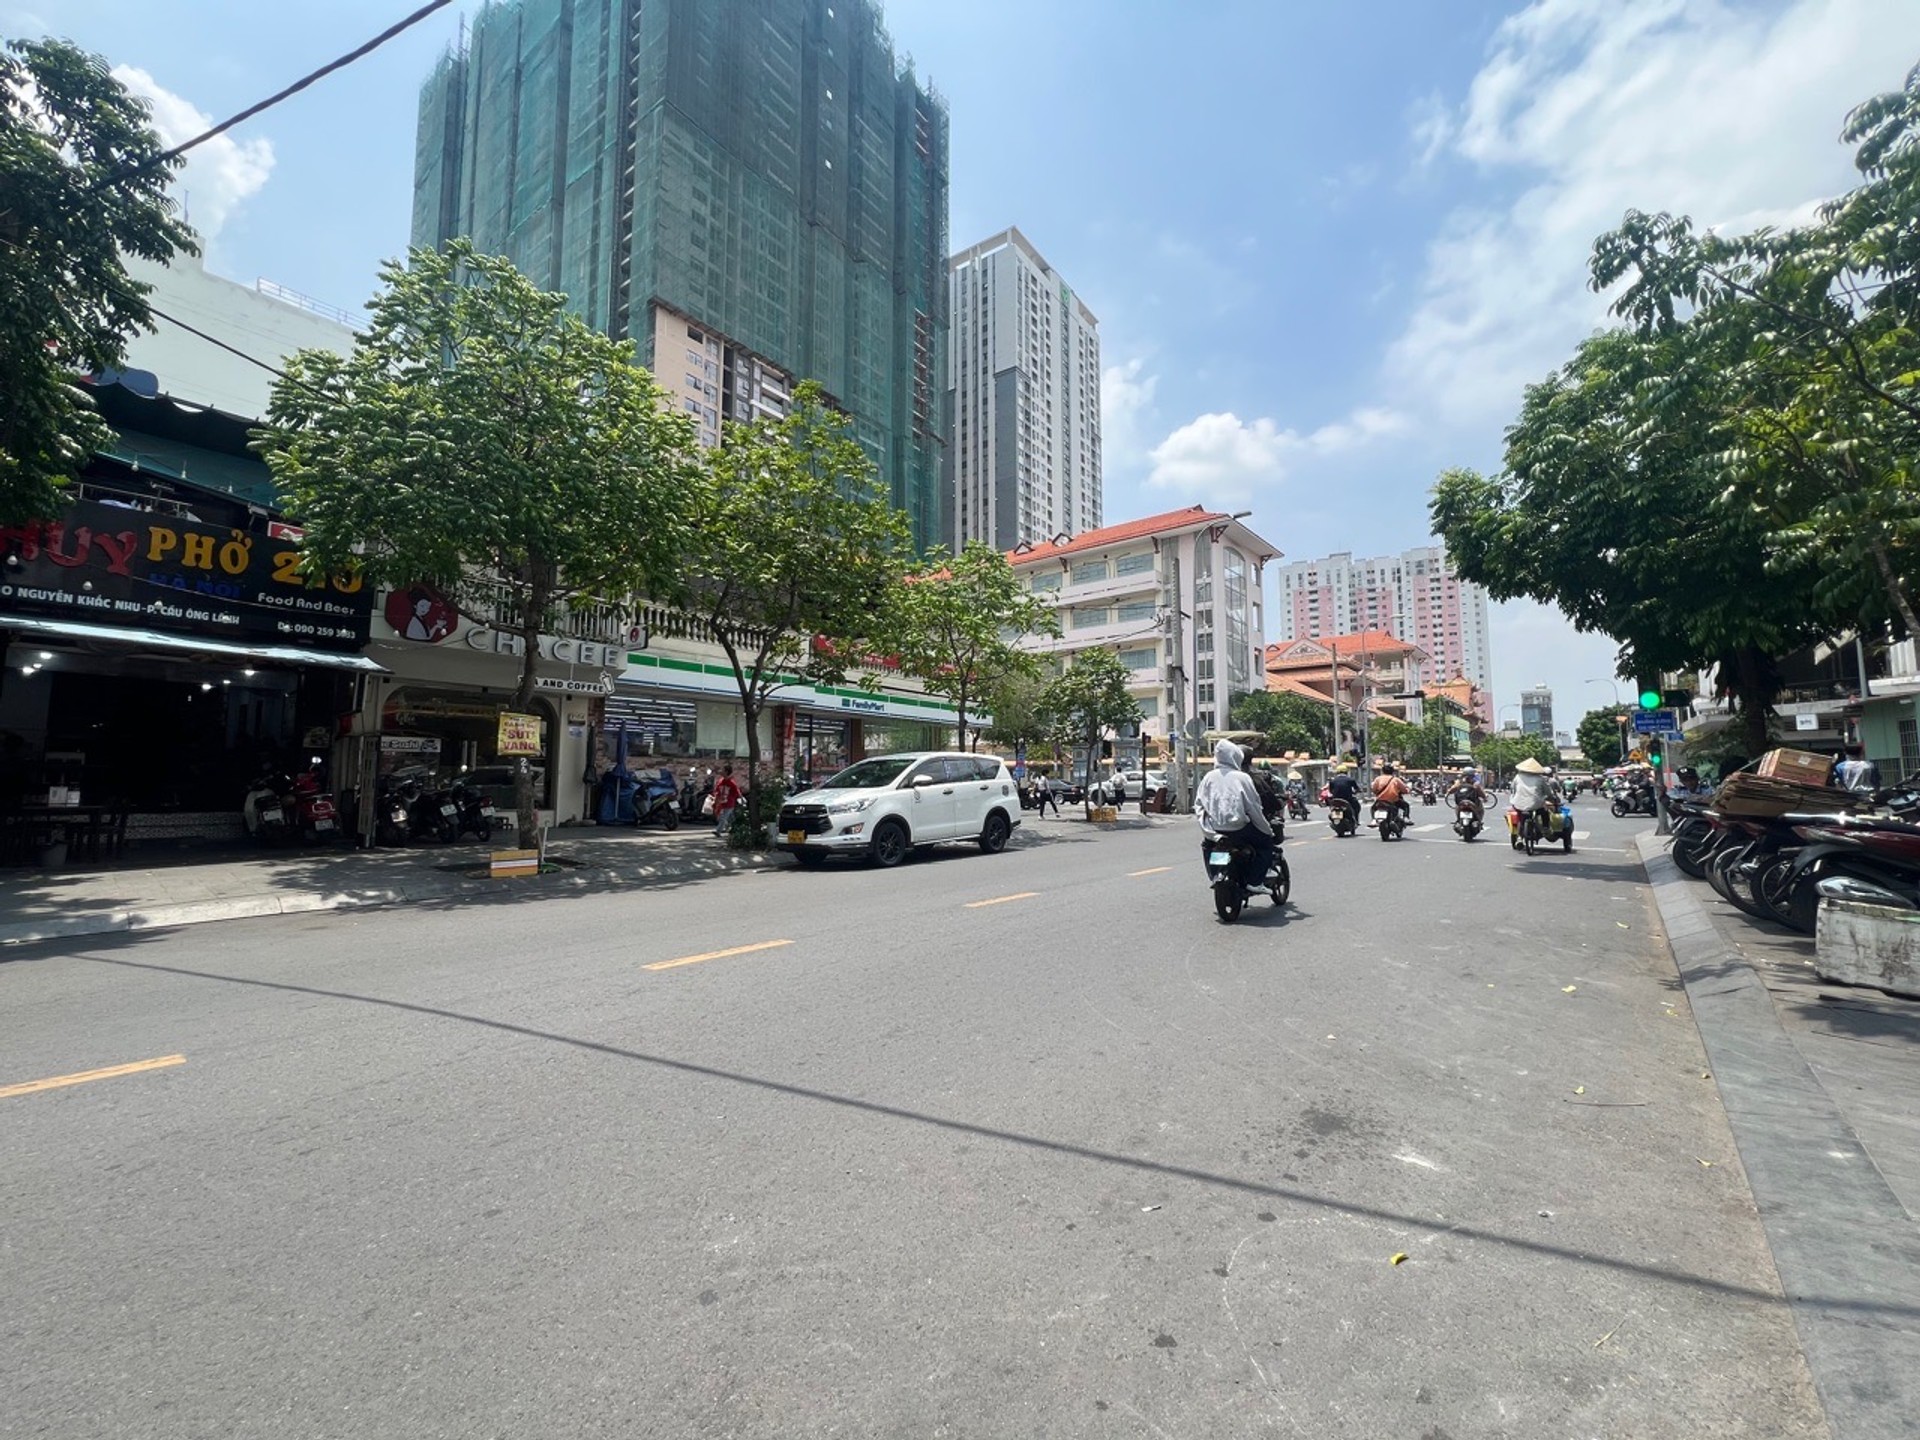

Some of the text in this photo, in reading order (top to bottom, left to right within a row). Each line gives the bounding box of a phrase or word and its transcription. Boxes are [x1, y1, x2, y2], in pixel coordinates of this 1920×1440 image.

[147, 526, 252, 575] PHỞ
[272, 551, 363, 593] 20
[257, 592, 356, 615] Food And Beer
[542, 679, 564, 689] AND
[852, 699, 884, 711] FamilyMart
